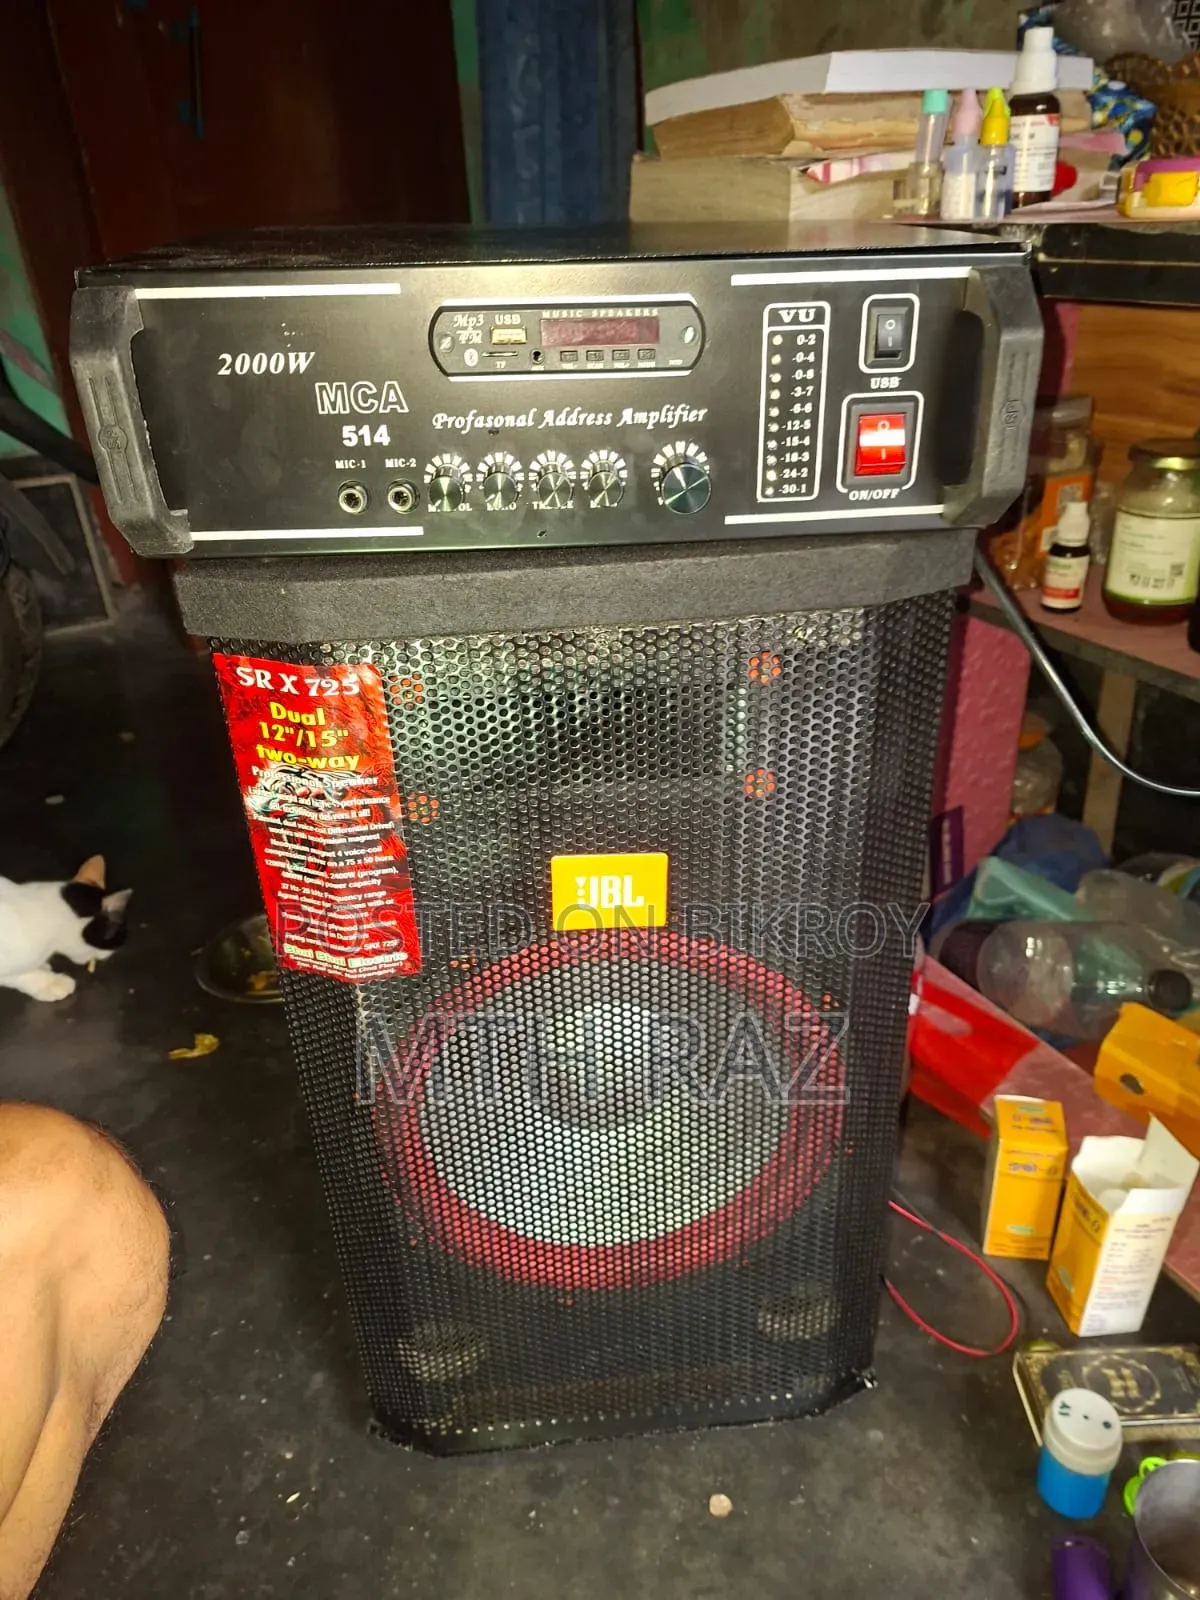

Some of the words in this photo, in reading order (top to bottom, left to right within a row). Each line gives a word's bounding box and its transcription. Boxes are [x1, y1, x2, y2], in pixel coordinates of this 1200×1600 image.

[542, 309, 584, 318] MUSIC
[778, 308, 816, 323] VU
[452, 313, 485, 331] Mp3
[494, 313, 522, 326] USB
[217, 351, 316, 376] 2000W
[870, 377, 902, 389] USB
[315, 381, 409, 415] MCA
[432, 409, 535, 434] Profasonal
[538, 407, 612, 429] Address
[616, 403, 708, 430] Amplifier
[342, 425, 391, 447] 514
[335, 459, 367, 469] MIC-1
[385, 458, 417, 468] MIC-2
[849, 488, 900, 501] ON/OFF
[304, 673, 360, 697] 725
[269, 701, 326, 726] Dual
[256, 744, 360, 771] two-way
[344, 845, 383, 857] voice-coil
[345, 858, 356, 866] 75
[330, 871, 356, 880] 2400W
[348, 878, 382, 889] capacity
[324, 892, 363, 903] Frequency
[364, 890, 386, 899] range
[576, 874, 645, 910] JBL
